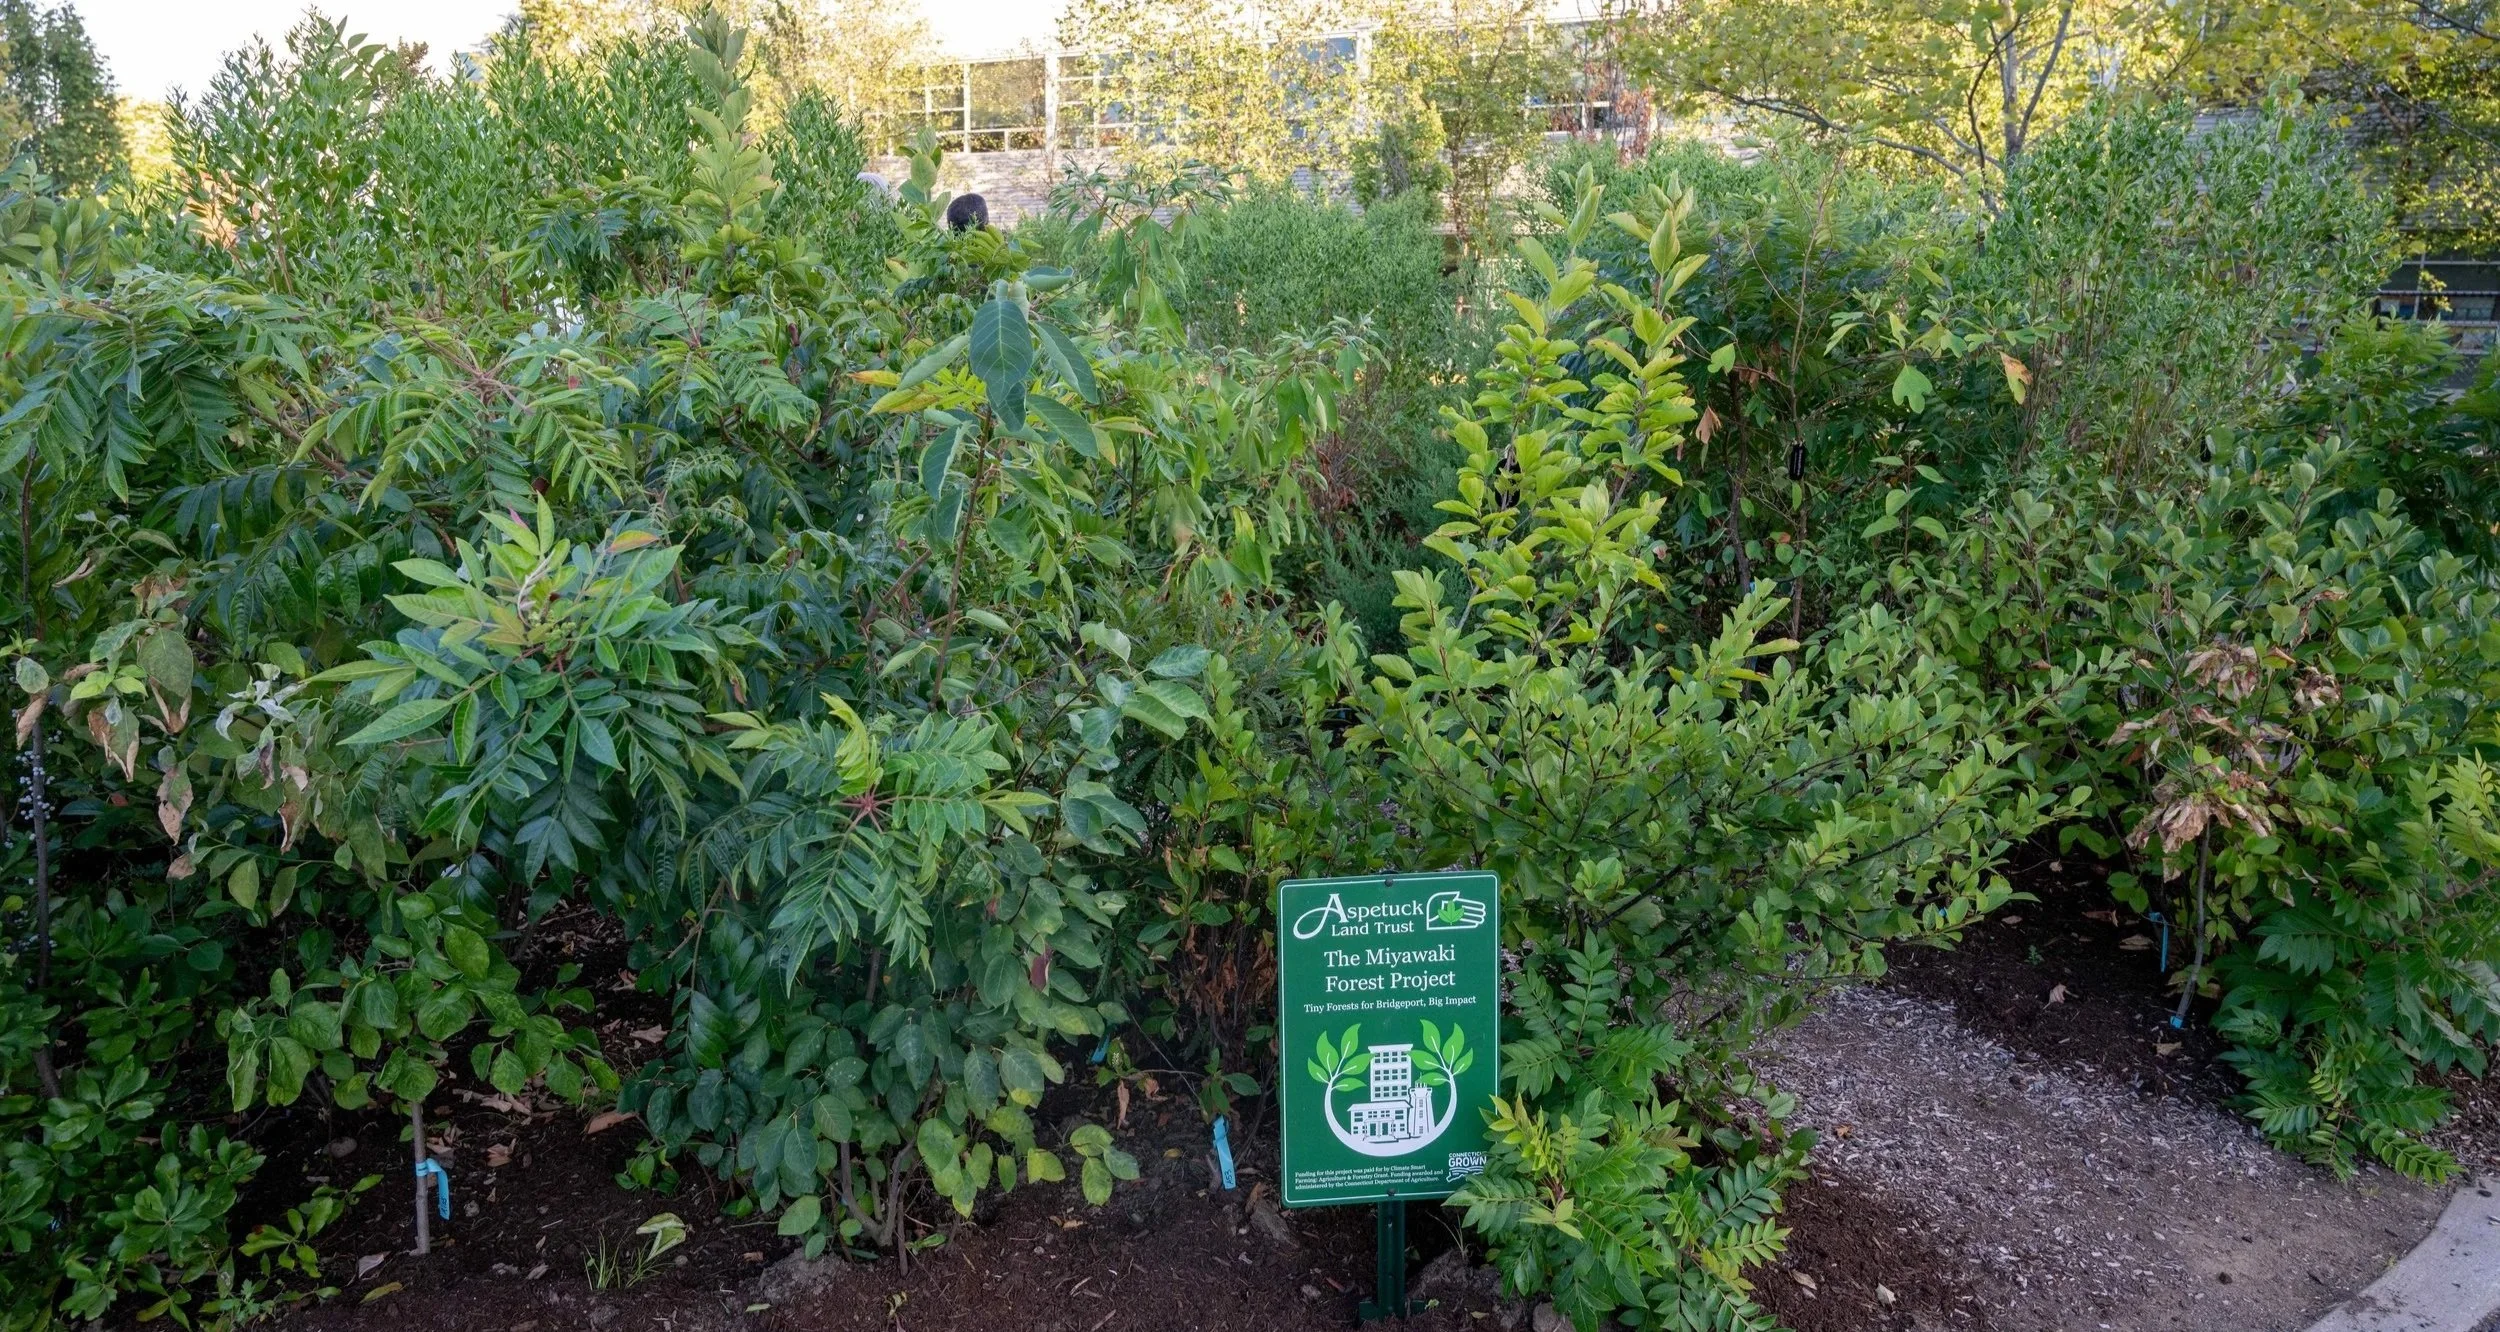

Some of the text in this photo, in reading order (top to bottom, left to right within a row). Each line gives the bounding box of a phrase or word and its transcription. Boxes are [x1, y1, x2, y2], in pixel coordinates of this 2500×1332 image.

[1293, 893, 1424, 939] Aspetuck
[1331, 920, 1415, 937] Land Trust
[1323, 943, 1456, 968] The Miyawaki
[1325, 970, 1456, 993] Forest Project
[1303, 995, 1477, 1014] Tiny Forests for Bridgeport, Big Impact
[1448, 1156, 1487, 1167] GROWN
